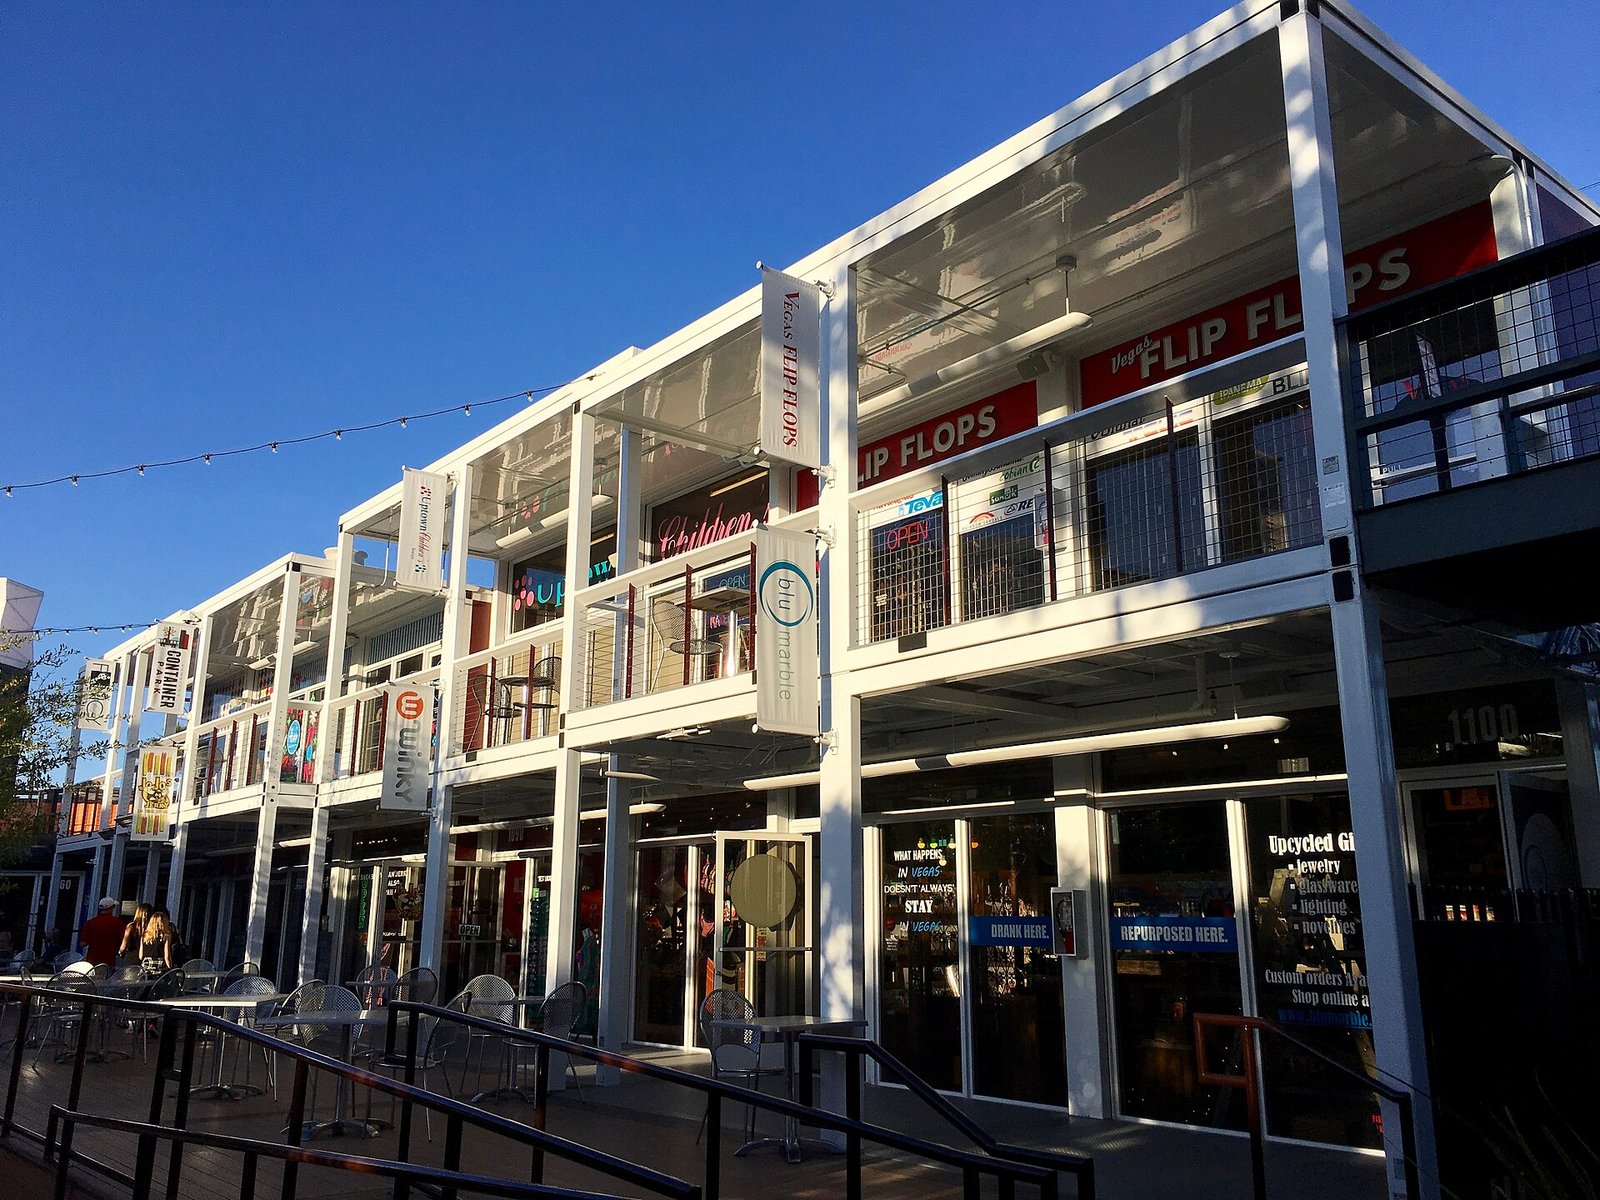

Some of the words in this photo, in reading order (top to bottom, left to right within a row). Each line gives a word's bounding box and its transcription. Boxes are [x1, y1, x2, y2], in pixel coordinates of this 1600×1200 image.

[1111, 335, 1153, 374] Vegas
[1141, 318, 1227, 379] FLIP
[1247, 248, 1411, 340] FLPS
[782, 344, 797, 385] FLIP
[782, 388, 798, 448] FLOPS
[901, 405, 996, 467] FLOPS
[419, 496, 431, 532] Uptown
[886, 519, 929, 551] OPEN
[719, 573, 746, 588] OPEN
[778, 576, 795, 611] blu
[778, 630, 795, 700] marble
[153, 660, 164, 695] PARK
[160, 650, 182, 709] CONTAINER
[1448, 703, 1519, 745] 1100
[1269, 834, 1333, 856] Upcycled
[894, 850, 911, 862] WHAT
[913, 849, 943, 862] HAPPENS
[898, 867, 908, 878] IN
[911, 866, 941, 878] VEGAS
[1296, 859, 1341, 876] jewelry
[884, 885, 917, 894] DOESN'T
[1299, 877, 1359, 895] glassware
[905, 899, 934, 914] STAY
[1300, 898, 1347, 916] lighting
[460, 925, 480, 936] OPEN
[991, 923, 1022, 939] DRANK
[1024, 925, 1050, 940] HERE.
[1120, 924, 1193, 942] REPURPOSED
[1196, 927, 1229, 944] HERE.
[1302, 917, 1356, 936] novelties
[1265, 968, 1303, 985] Custom
[1306, 972, 1343, 987] orders
[1291, 989, 1319, 1006] Shop
[1322, 990, 1359, 1007] online
